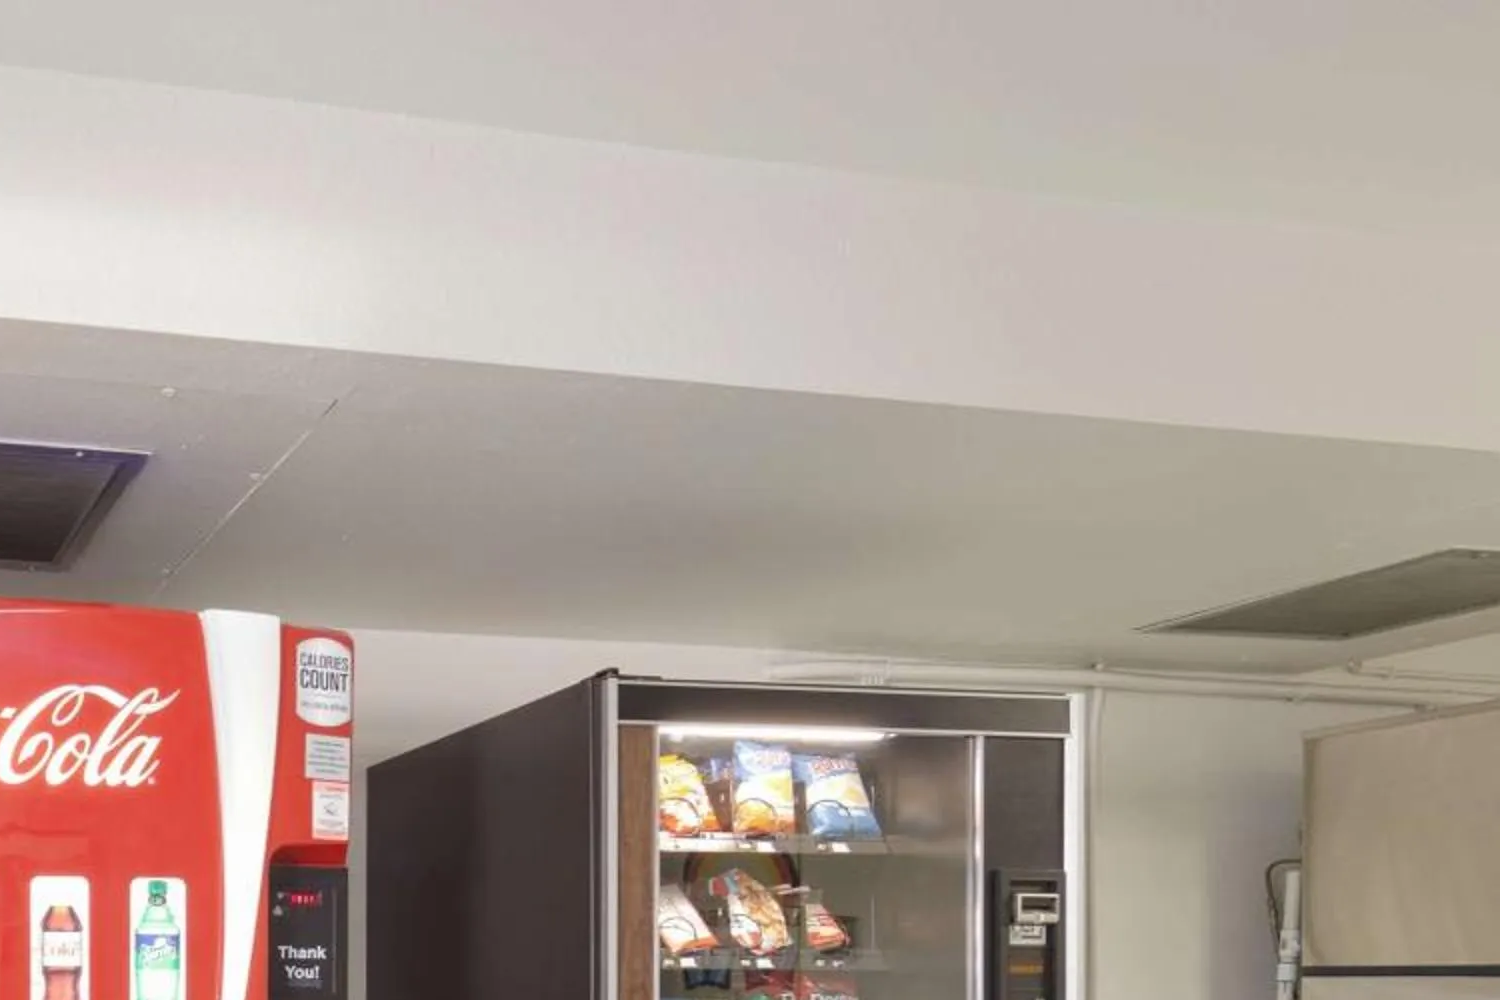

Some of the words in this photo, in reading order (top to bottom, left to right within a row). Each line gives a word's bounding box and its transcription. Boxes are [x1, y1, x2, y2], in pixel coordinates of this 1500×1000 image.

[300, 668, 349, 692] COUNT
[277, 945, 327, 959] Thank
[285, 965, 320, 980] You!
